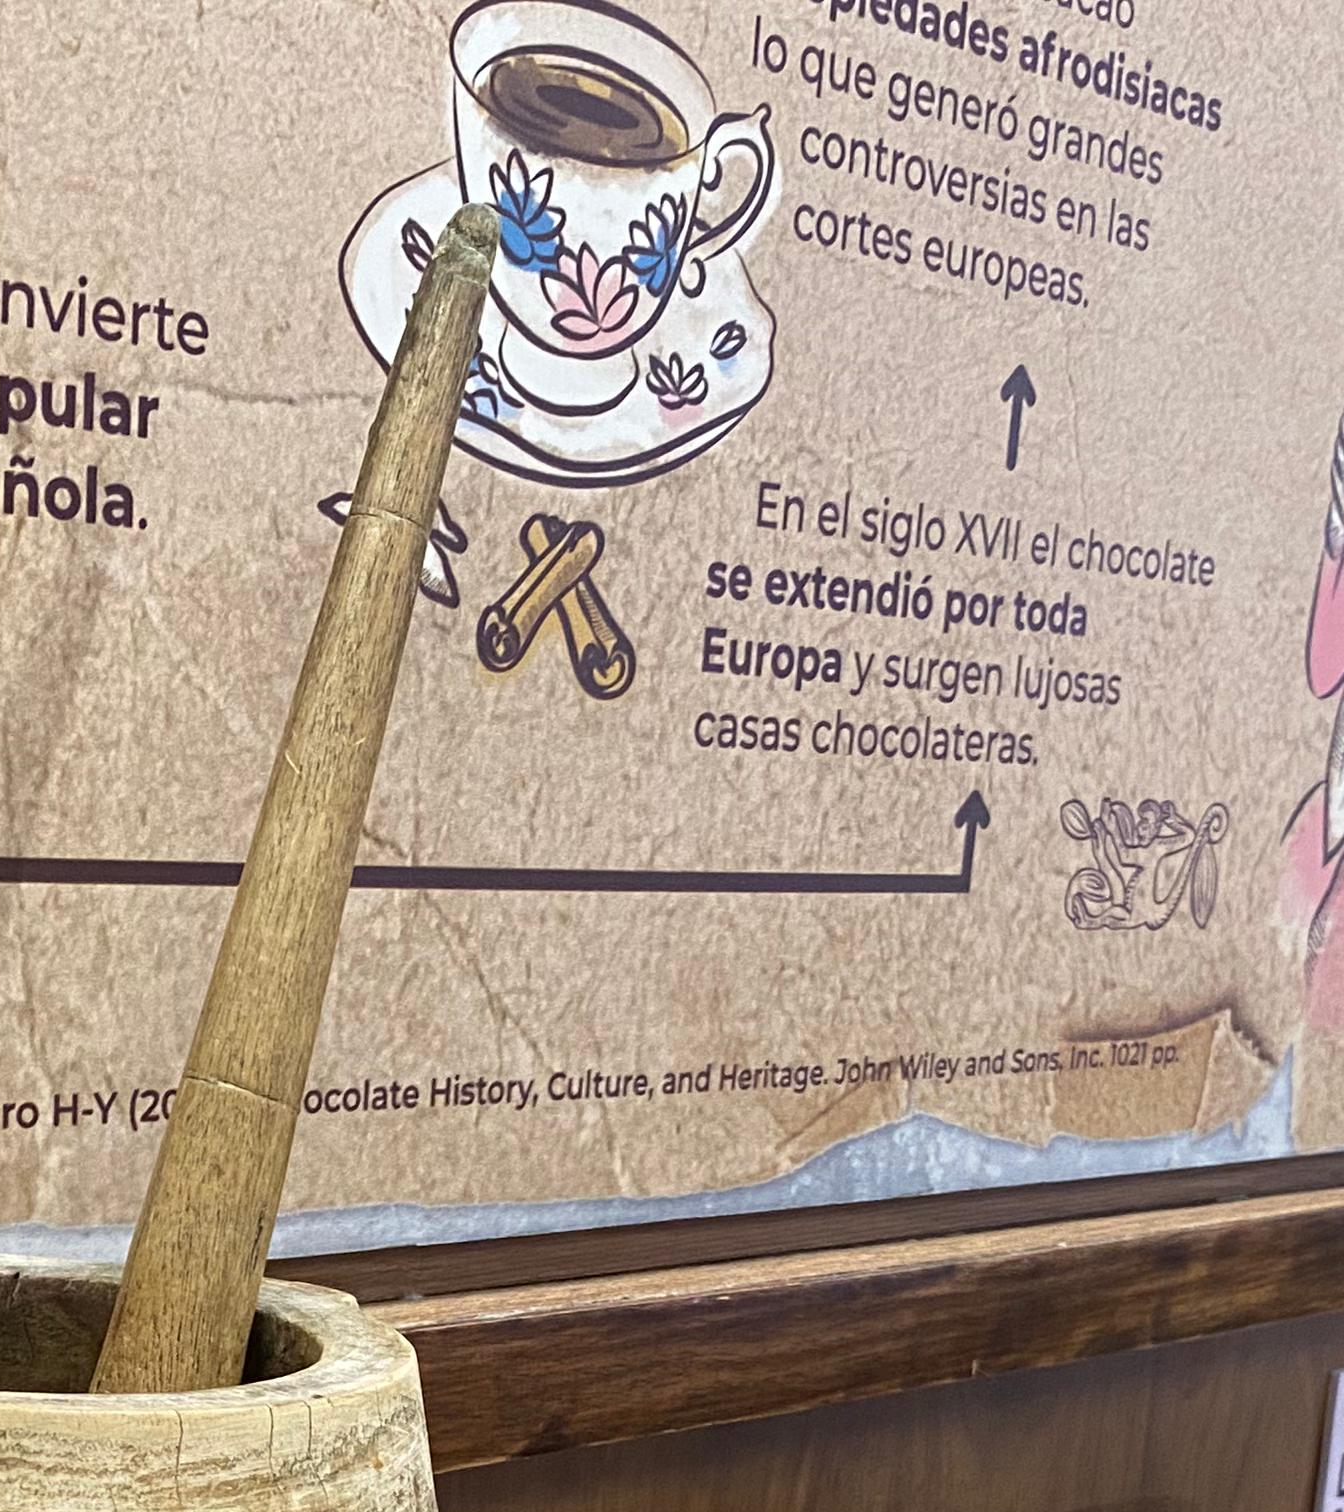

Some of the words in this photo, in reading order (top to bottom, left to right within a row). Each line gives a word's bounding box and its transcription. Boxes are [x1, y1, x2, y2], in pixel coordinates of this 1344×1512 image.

[753, 16, 787, 73] lo
[801, 46, 876, 99] que
[888, 73, 1017, 140] generó
[1028, 115, 1162, 184] grandes
[1019, 31, 1221, 131] afrodisiacas
[801, 127, 1046, 223] controversias
[1057, 198, 1095, 237] en
[1108, 198, 1150, 251] las
[794, 205, 912, 264] cortes
[924, 237, 1088, 308] europeas.
[757, 482, 804, 532] En
[818, 491, 851, 538] el
[861, 497, 945, 557] siglo
[955, 512, 1021, 561] XVII
[1031, 523, 1059, 566] el
[1068, 529, 1214, 586] chocolate
[706, 562, 752, 600] se
[765, 567, 933, 620] extendió
[943, 590, 1004, 633] por
[1014, 591, 1087, 636] toda
[702, 627, 841, 691] Europa
[850, 652, 875, 696] y
[884, 655, 1002, 703] surgen
[1015, 655, 1121, 710] lujosas
[695, 712, 800, 752] casas
[812, 710, 1037, 765] chocolateras.
[53, 1092, 118, 1127] H-Y
[304, 1079, 419, 1113] ocolate
[430, 1075, 538, 1112] History,
[548, 1070, 655, 1103] Culture,
[663, 1064, 710, 1095] and
[719, 1060, 829, 1095] Heritage.
[835, 1056, 891, 1087] John
[899, 1052, 960, 1085] Wiley
[965, 1049, 1006, 1076] and
[1070, 1045, 1103, 1070] Inc.
[1112, 1042, 1147, 1066] 1021
[1151, 1046, 1179, 1069] pp.
